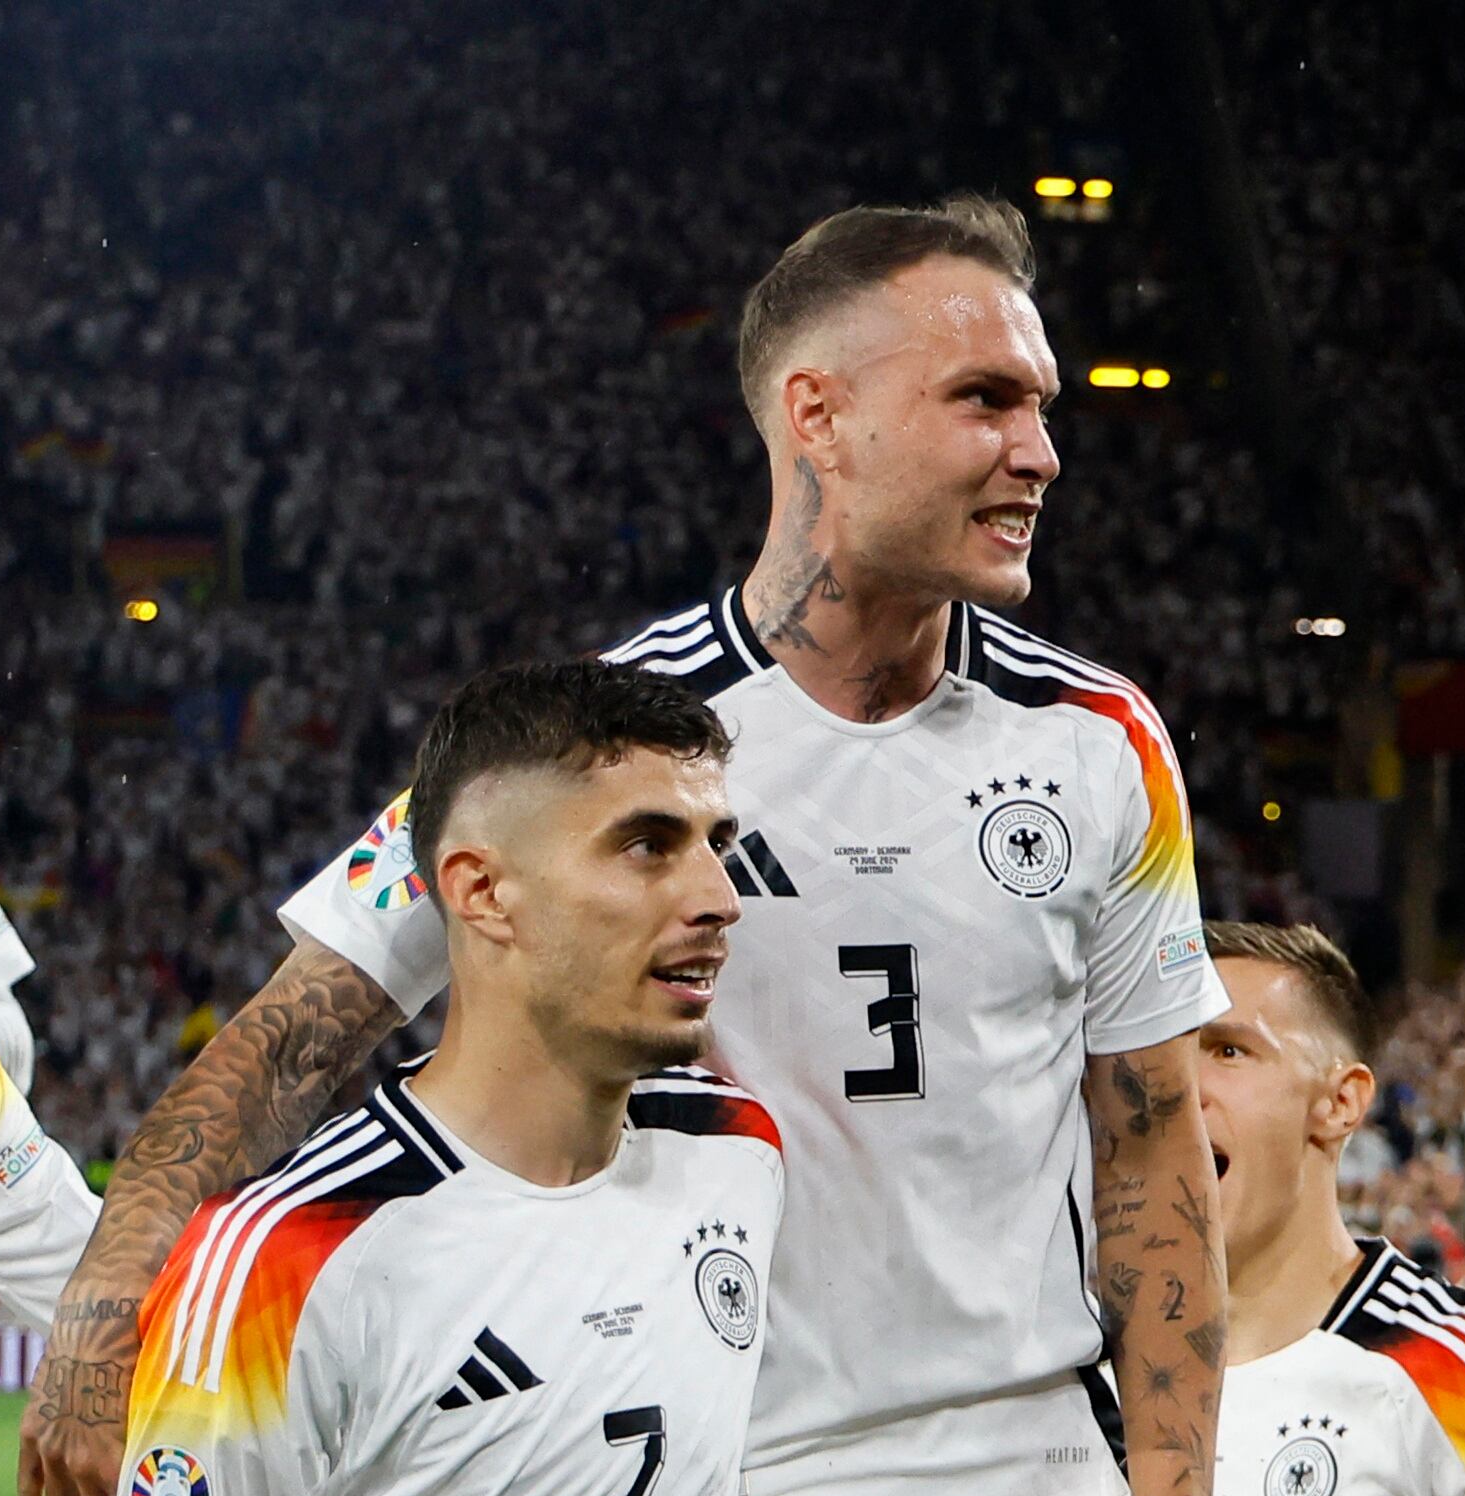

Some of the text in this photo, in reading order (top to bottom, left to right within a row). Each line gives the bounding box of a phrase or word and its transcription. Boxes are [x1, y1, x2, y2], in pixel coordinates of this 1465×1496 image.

[995, 811, 1049, 834] DEUTSCHER
[838, 943, 926, 1103] 3
[706, 1260, 745, 1284] DEUTSCHER
